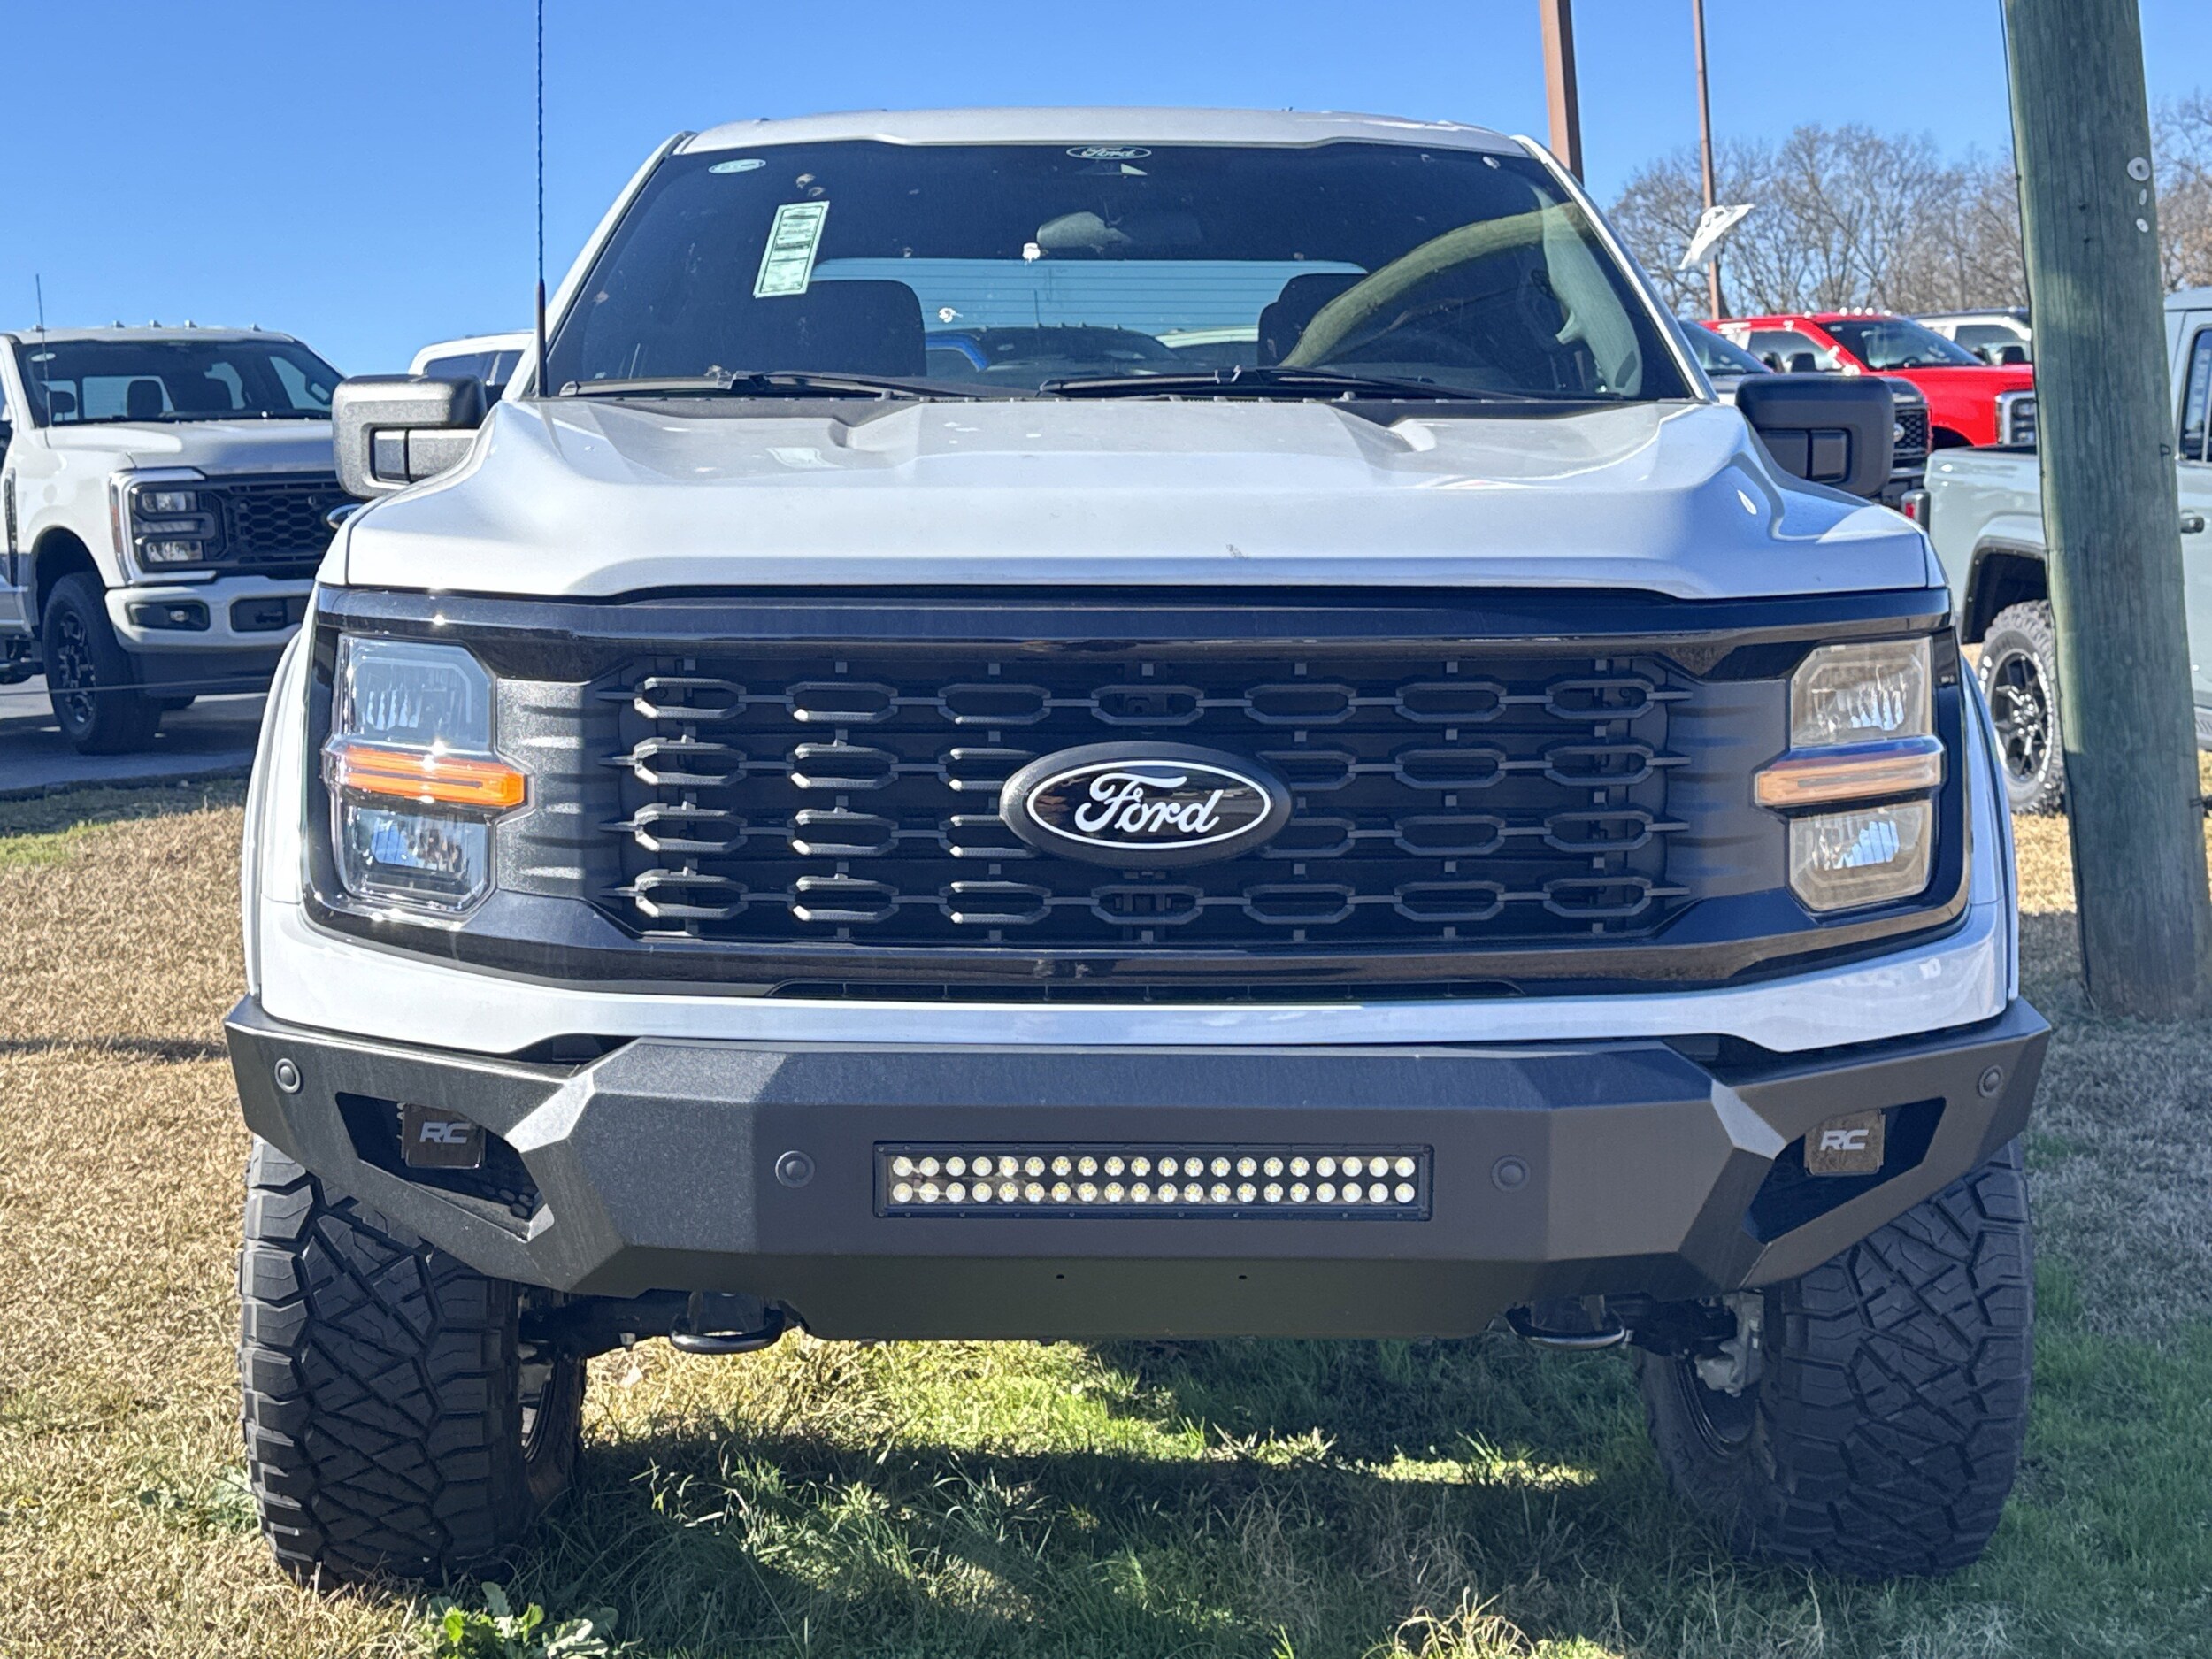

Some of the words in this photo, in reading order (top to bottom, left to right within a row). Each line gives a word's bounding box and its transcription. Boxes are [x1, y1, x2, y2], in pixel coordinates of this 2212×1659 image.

[1081, 147, 1136, 157] Ford
[1074, 772, 1225, 833] Ford
[419, 1121, 472, 1144] RC
[1820, 1129, 1869, 1151] RC
